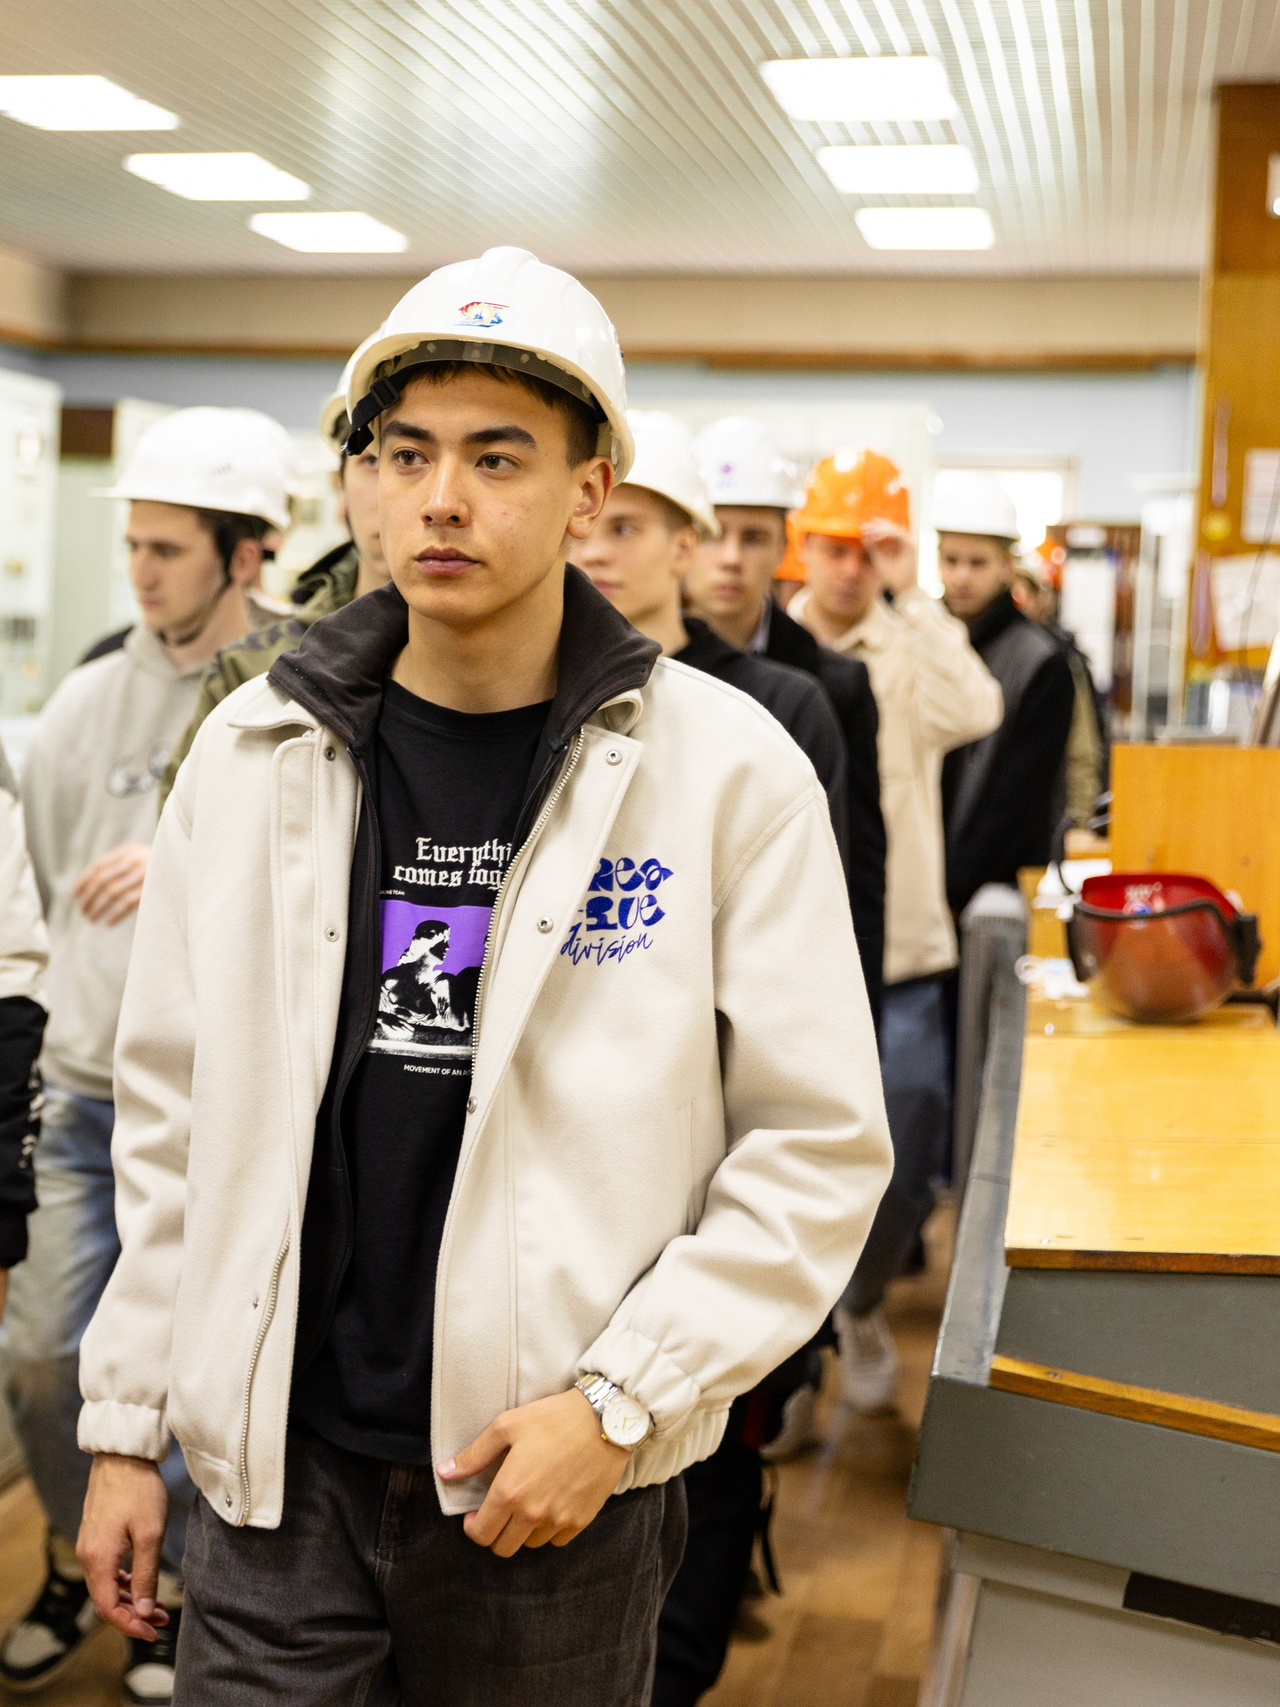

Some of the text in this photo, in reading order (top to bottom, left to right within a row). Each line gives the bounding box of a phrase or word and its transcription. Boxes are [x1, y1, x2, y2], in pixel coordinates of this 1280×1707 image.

[392, 865, 464, 888] comes
[560, 921, 654, 966] division
[403, 1064, 440, 1075] MOVEMENT
